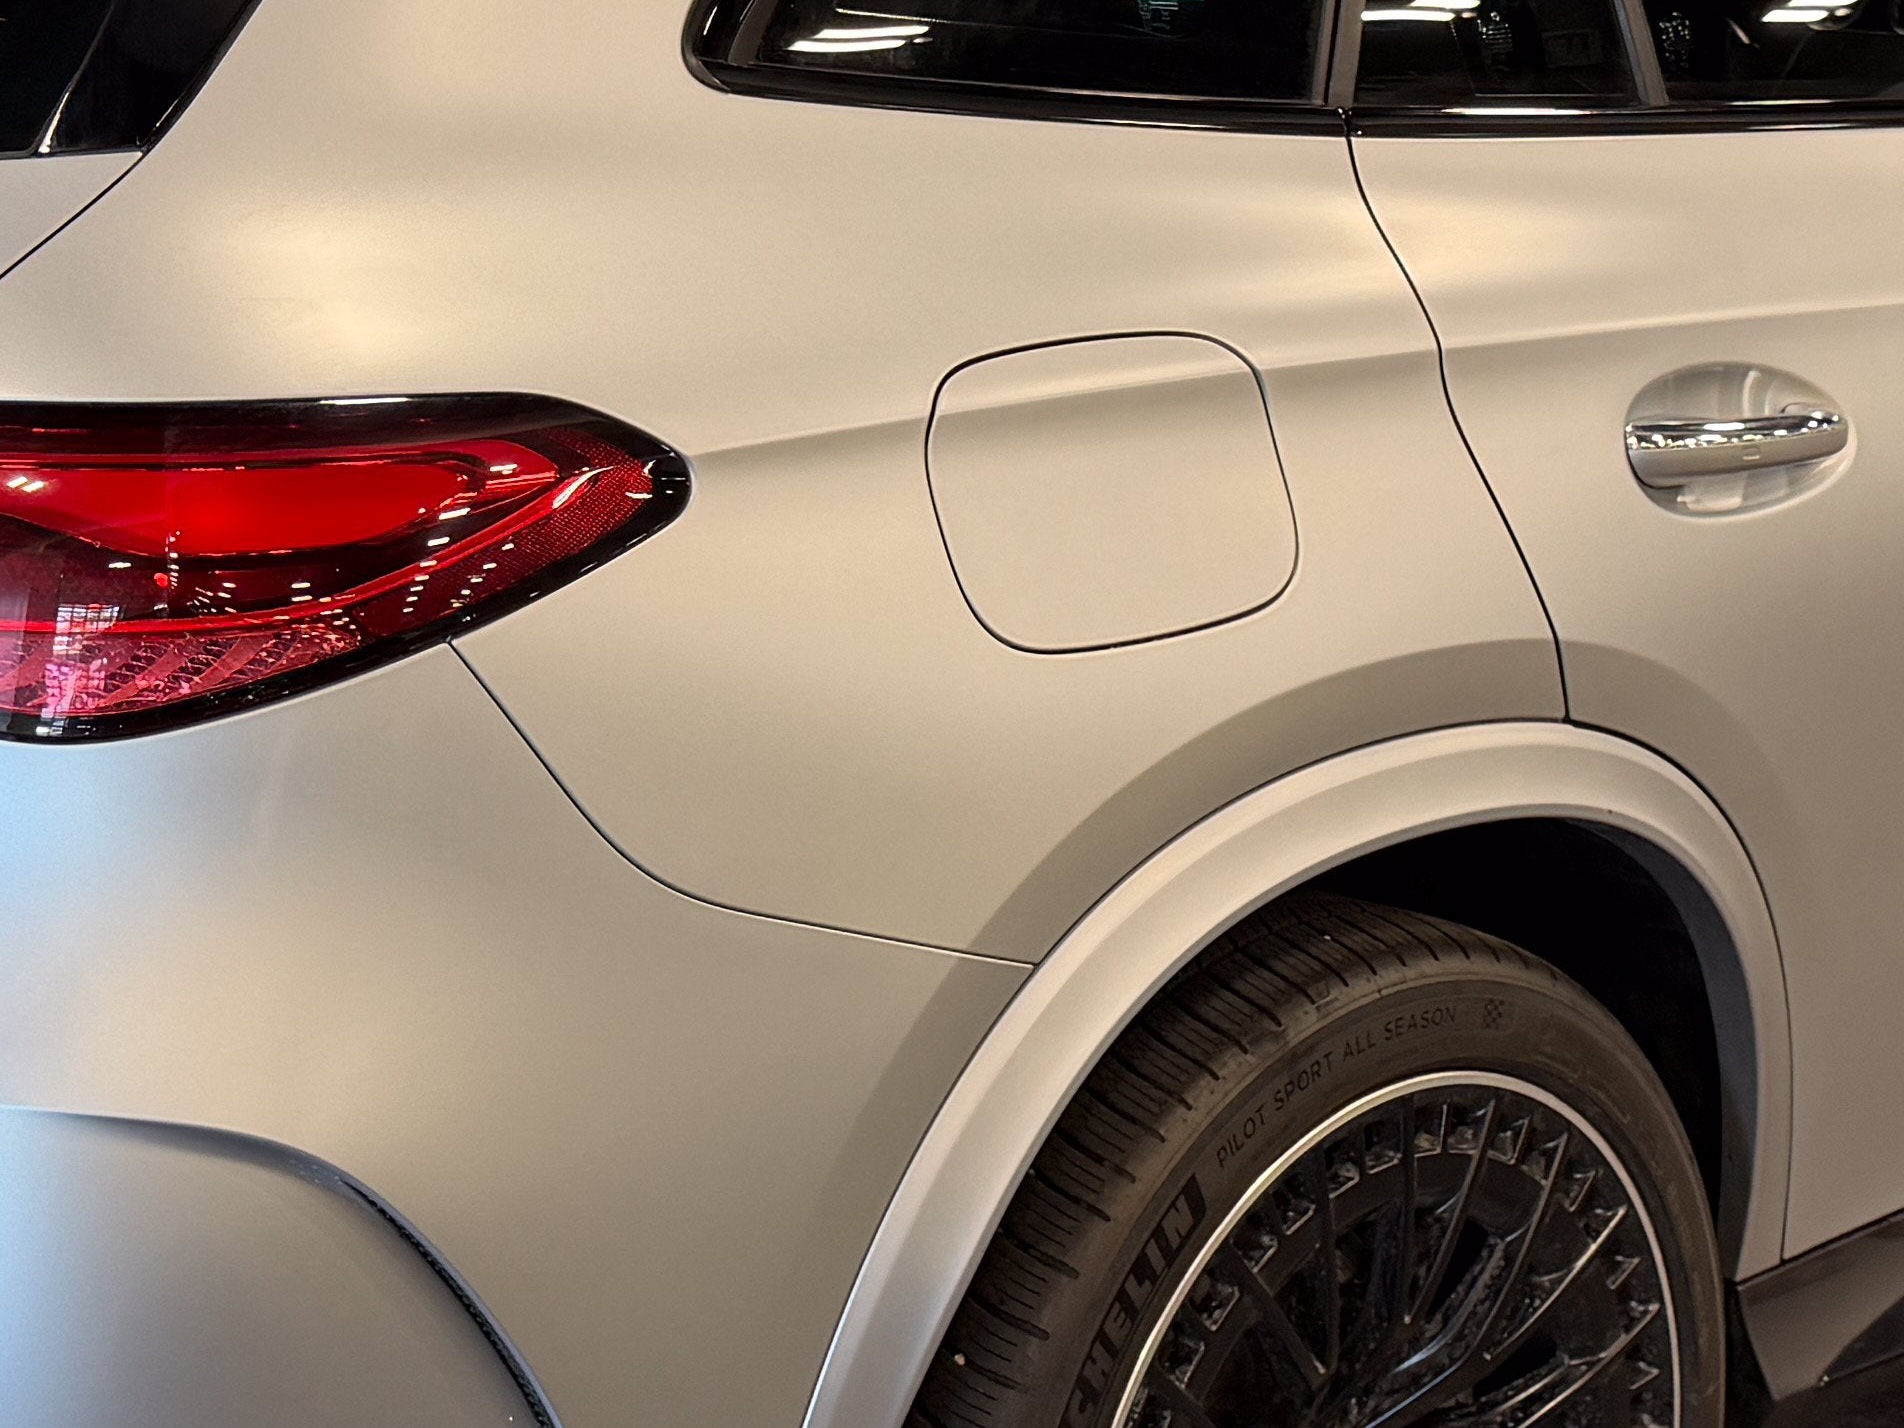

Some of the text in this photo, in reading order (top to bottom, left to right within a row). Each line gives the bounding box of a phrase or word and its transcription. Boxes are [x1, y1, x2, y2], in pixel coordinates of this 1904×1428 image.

[1215, 1004, 1458, 1168] PILOT SPORT ALL SEASON
